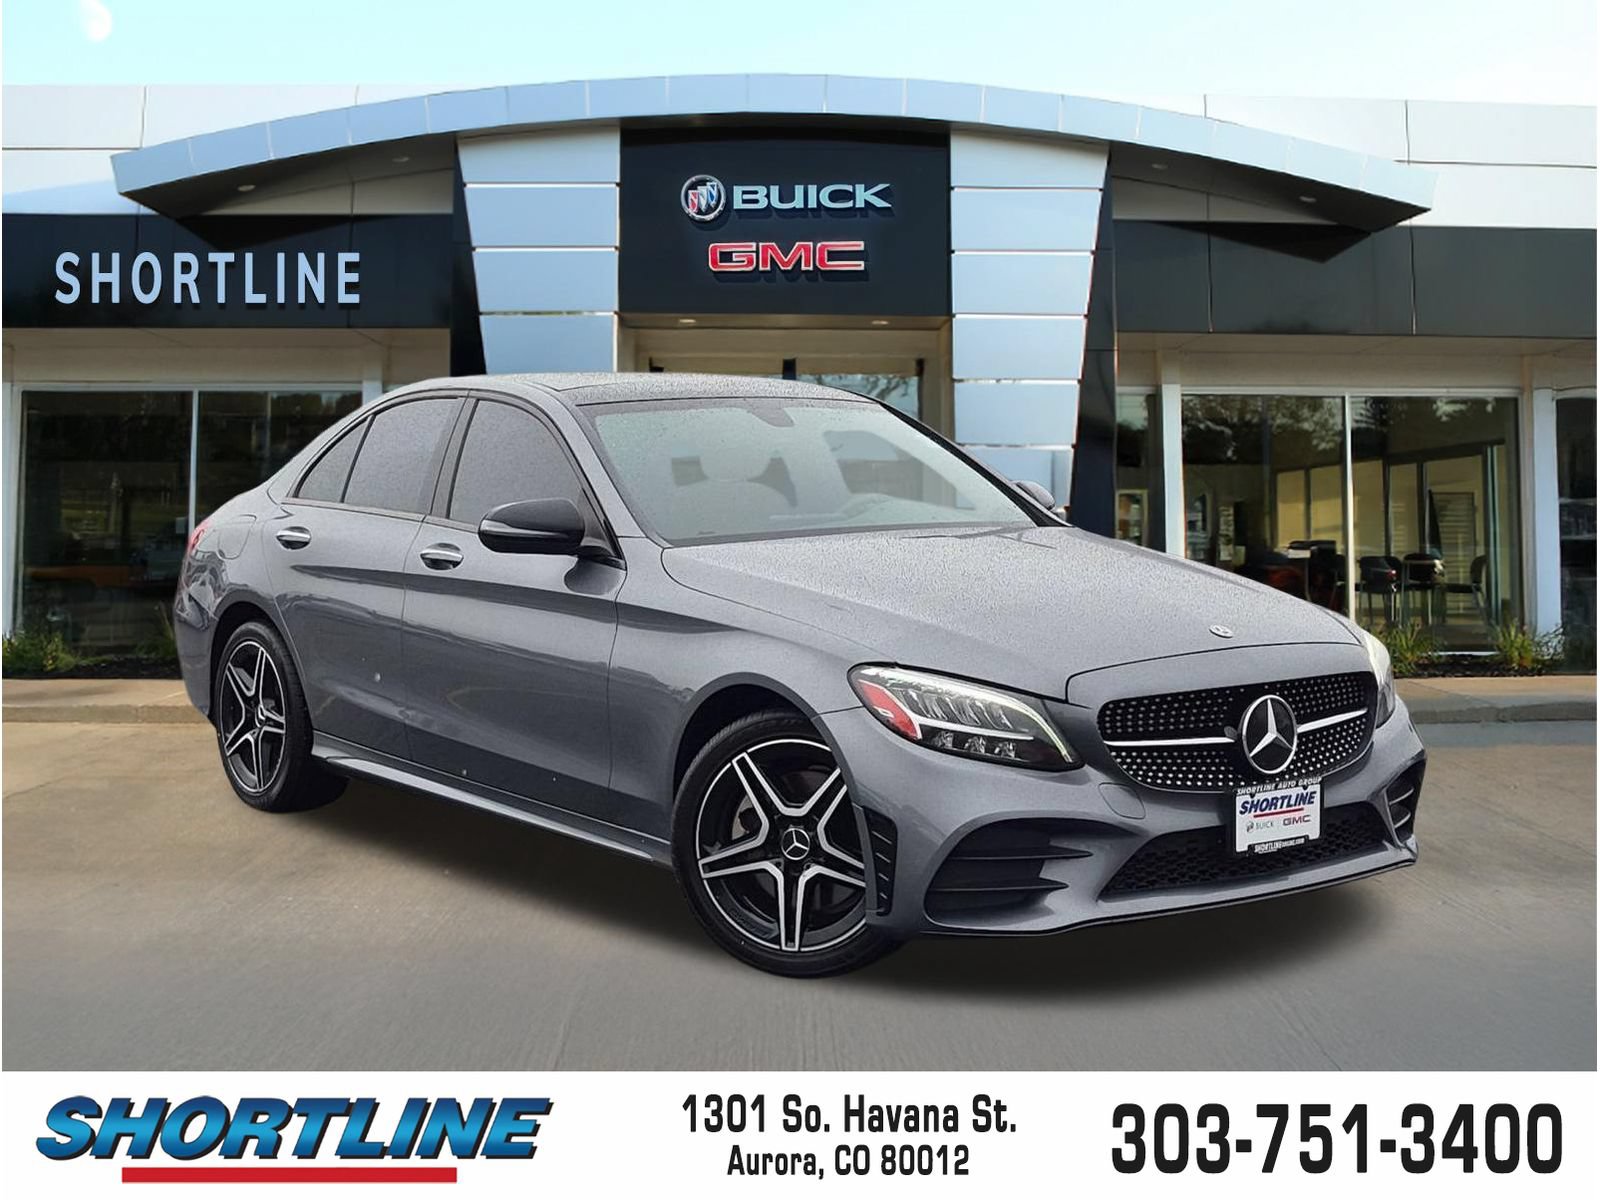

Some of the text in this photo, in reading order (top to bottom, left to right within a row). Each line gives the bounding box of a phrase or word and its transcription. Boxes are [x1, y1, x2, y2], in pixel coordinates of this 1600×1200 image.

[733, 183, 893, 210] BUICK
[708, 240, 865, 272] GMC
[54, 251, 361, 305] SHORTLINE
[1236, 777, 1322, 796] SHORTLINE AUTO GROUP
[1239, 791, 1317, 815] SHORTLINE
[1255, 815, 1312, 830] BUICK GMC
